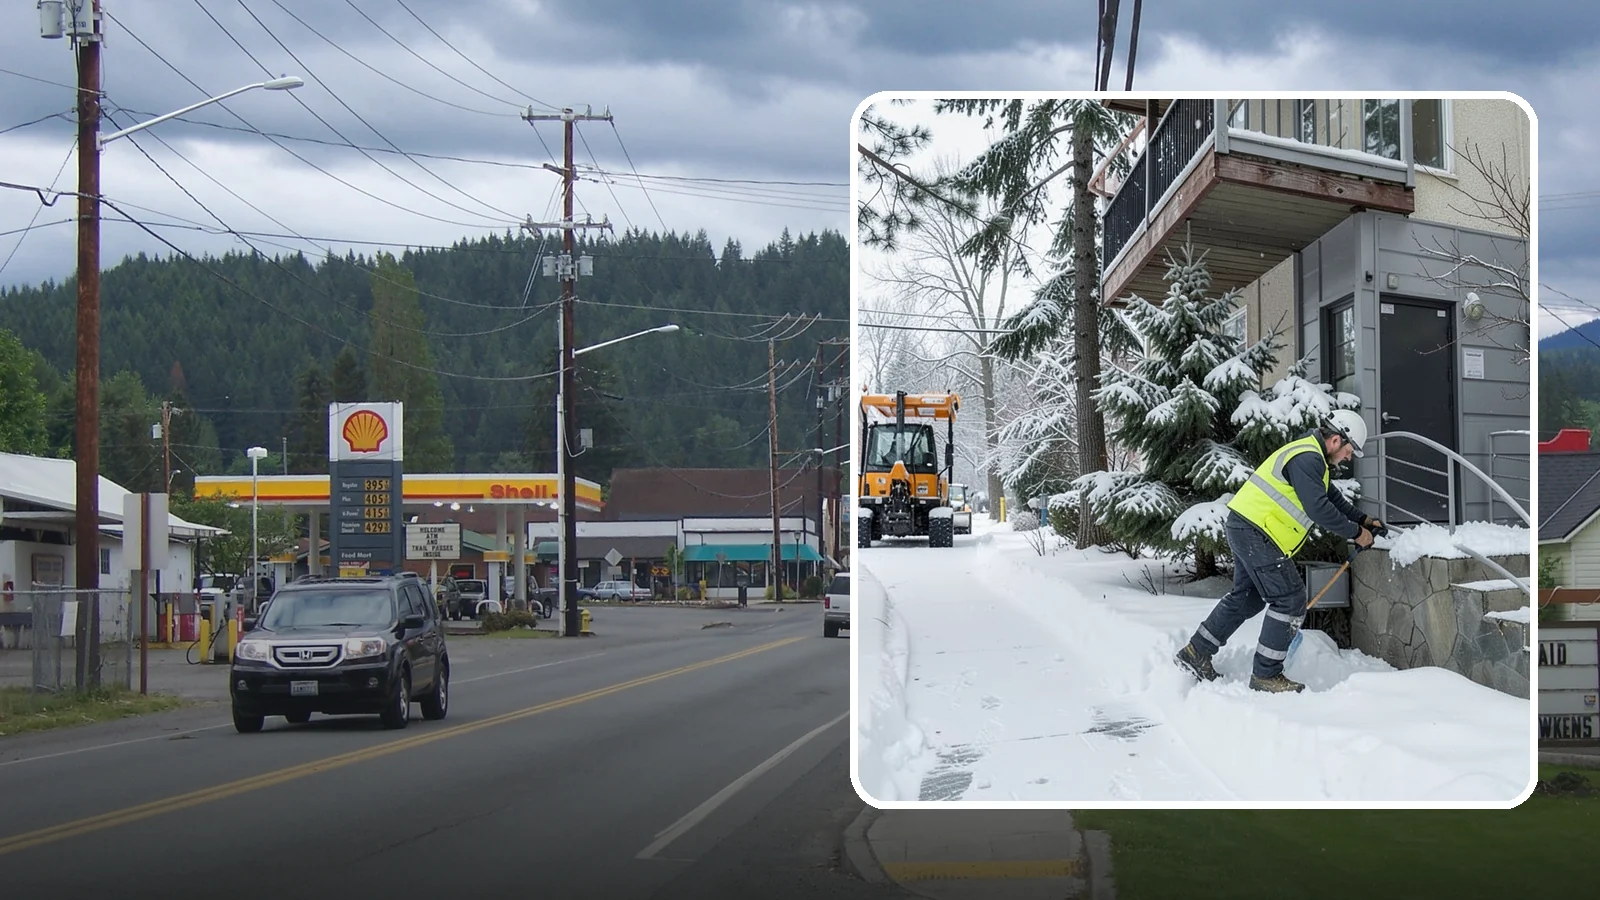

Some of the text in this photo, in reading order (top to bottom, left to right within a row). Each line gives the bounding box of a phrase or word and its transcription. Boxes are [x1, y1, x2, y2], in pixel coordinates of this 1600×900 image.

[365, 480, 384, 490] 395
[490, 484, 547, 498] Shell
[365, 494, 384, 504] 405
[365, 508, 384, 518] 415
[365, 522, 384, 532] 429
